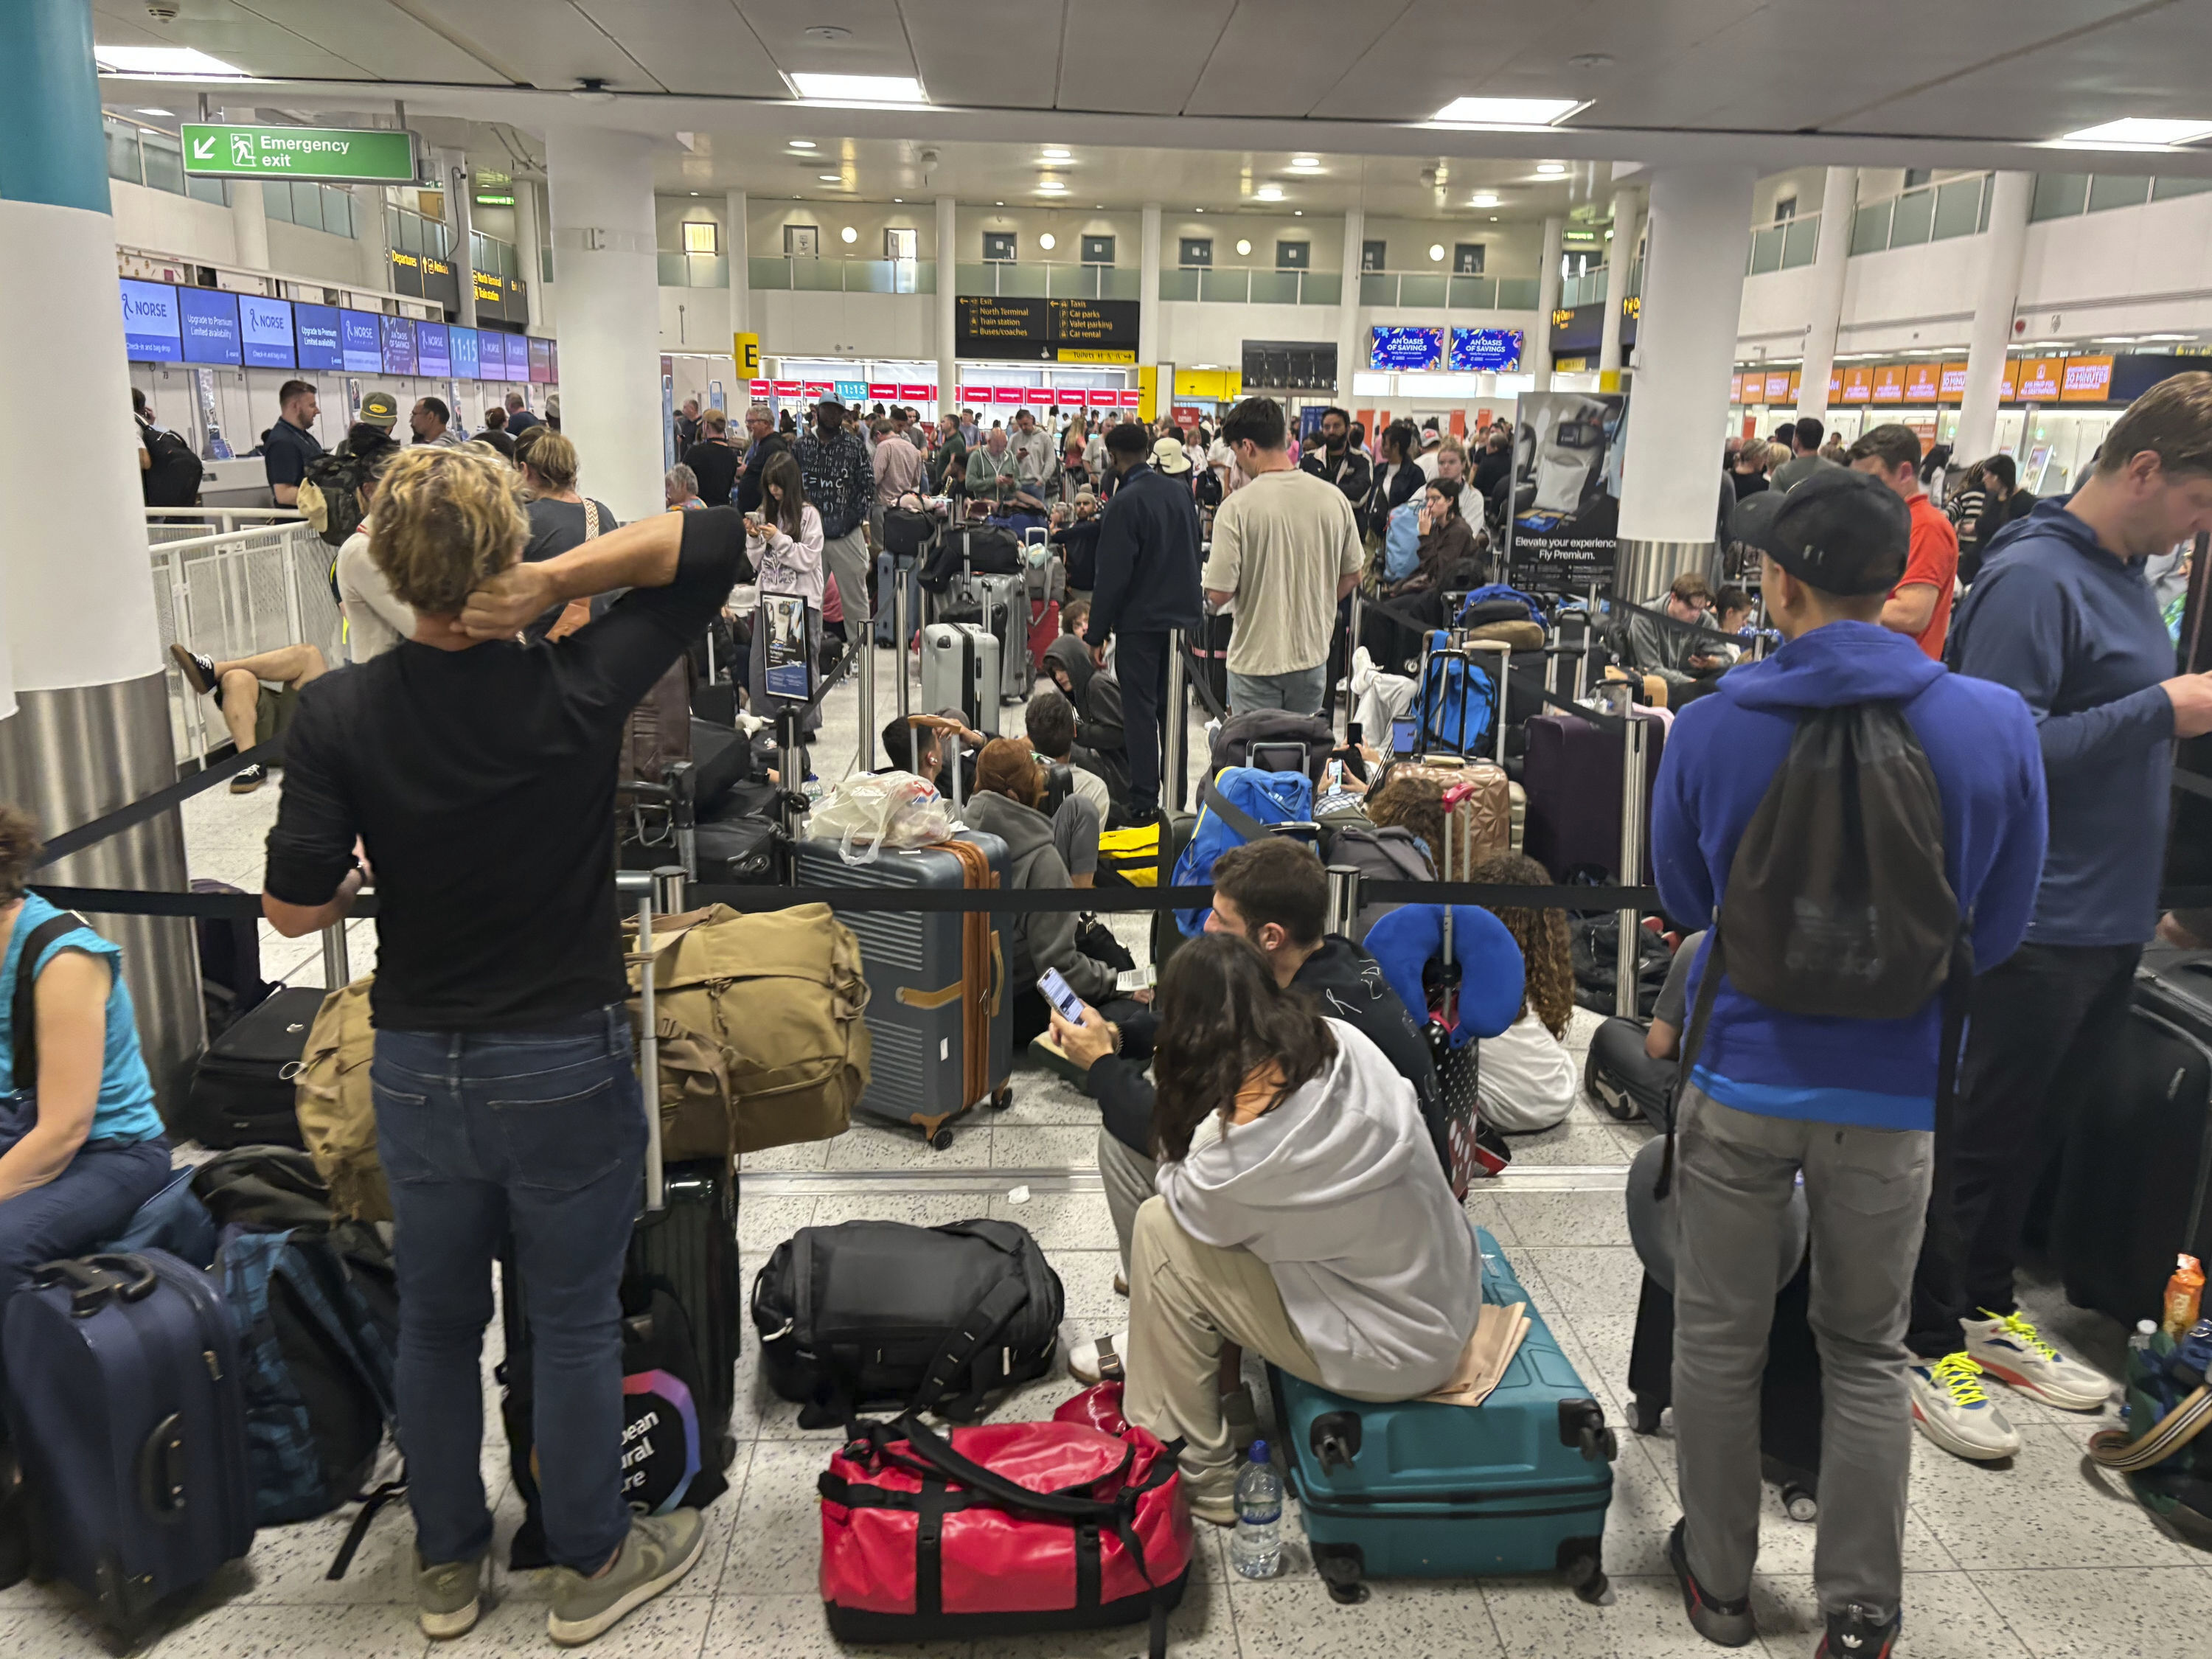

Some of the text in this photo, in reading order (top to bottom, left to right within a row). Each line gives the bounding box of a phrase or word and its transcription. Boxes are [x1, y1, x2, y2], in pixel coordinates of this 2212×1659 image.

[260, 135, 350, 155] Emergency
[262, 154, 291, 167] exit
[392, 249, 417, 268] Departures
[434, 260, 449, 275] Arrivals
[135, 301, 167, 318] NORSE
[1070, 300, 1087, 308] Taxis
[980, 307, 1029, 317] North Terminal
[1082, 311, 1101, 320] parks
[187, 314, 233, 327] Upgrade to Premium
[260, 315, 285, 330] NORSE
[980, 318, 996, 326] Train
[1070, 320, 1113, 331] Valet parking
[191, 327, 208, 337] Limited
[302, 326, 318, 336] Upgrade
[321, 327, 337, 337] Premium
[353, 325, 373, 339] NORSE
[980, 328, 1028, 337] Buses/coaches
[1082, 330, 1102, 338] rental
[304, 337, 318, 346] Limited
[428, 335, 444, 347] NORSE
[451, 337, 478, 362] 11:15
[745, 344, 757, 368] E
[837, 383, 866, 395] 11:15
[1515, 537, 1547, 547] Elevate
[1548, 538, 1570, 549] your
[1539, 549, 1596, 562] Fly Premium.
